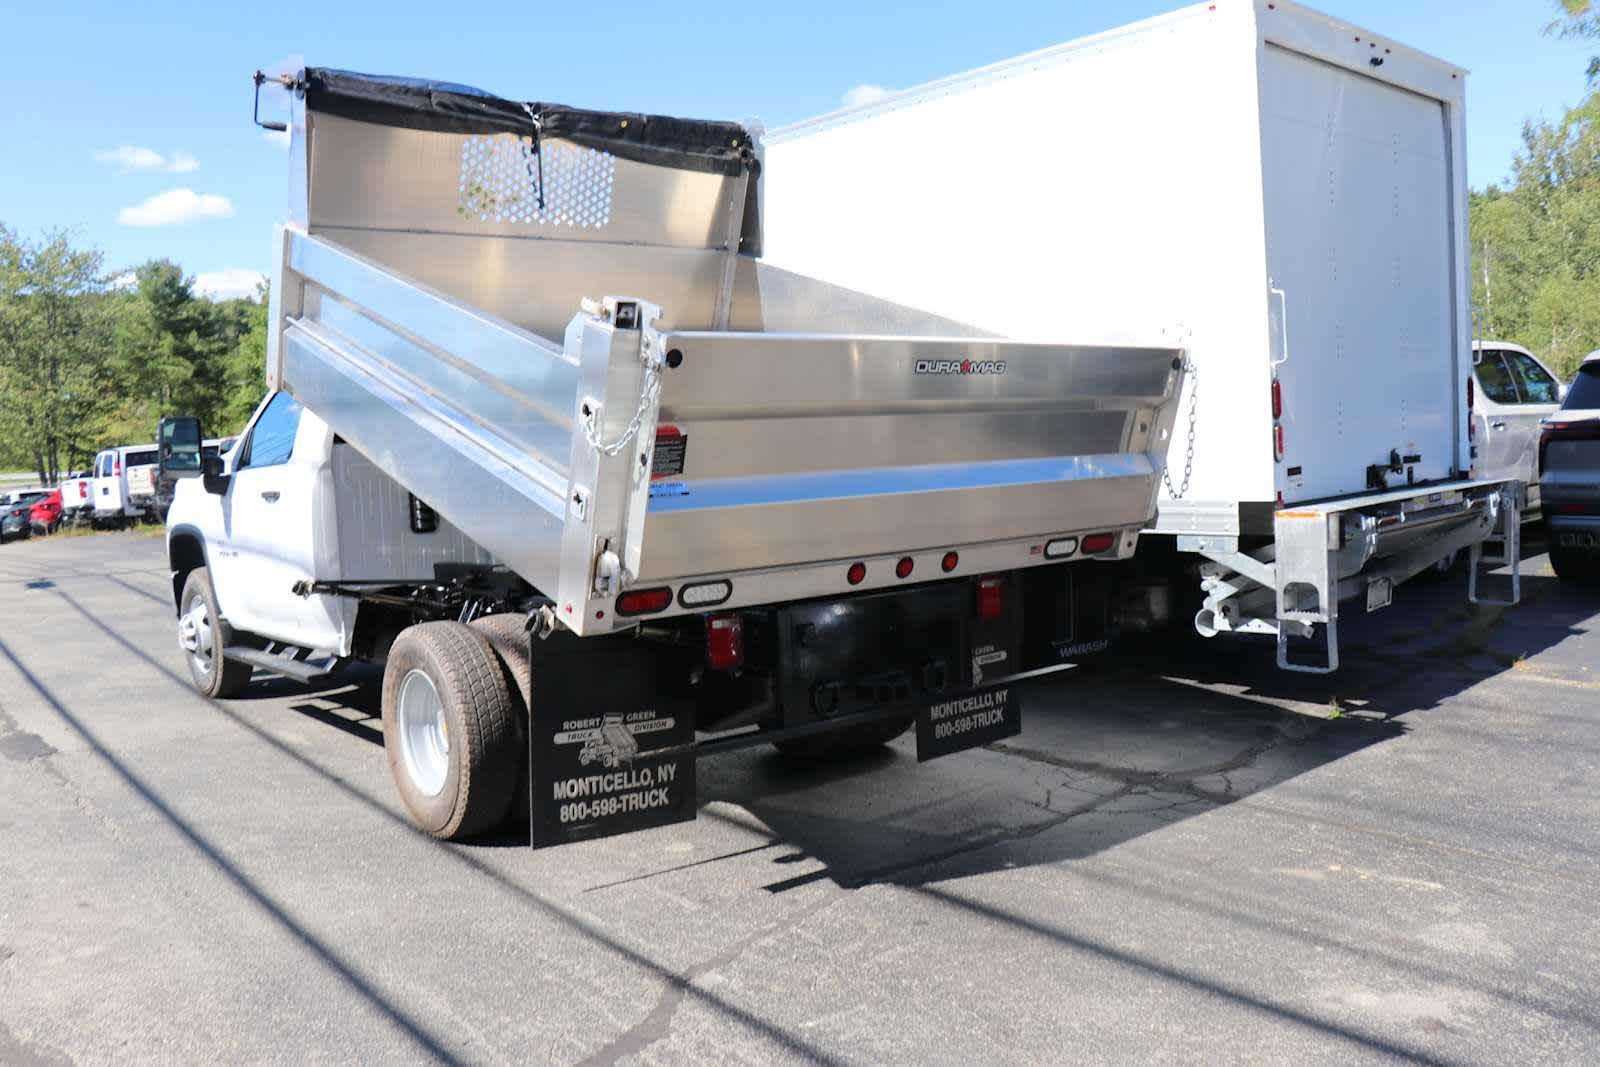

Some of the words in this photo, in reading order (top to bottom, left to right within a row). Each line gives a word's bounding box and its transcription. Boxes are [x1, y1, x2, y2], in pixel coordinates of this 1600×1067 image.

[930, 693, 994, 720] MONTICELLO,
[996, 689, 1008, 705] NY
[562, 718, 601, 731] ROBERT
[626, 710, 656, 722] GREEN
[567, 732, 593, 742] TRUCK
[634, 720, 667, 732] DIVISION
[935, 707, 1004, 739] 800-598-TRUCK
[553, 768, 654, 801] MONTICELLO,
[657, 763, 677, 784] NY
[560, 787, 669, 824] 800-598-TRUCK
